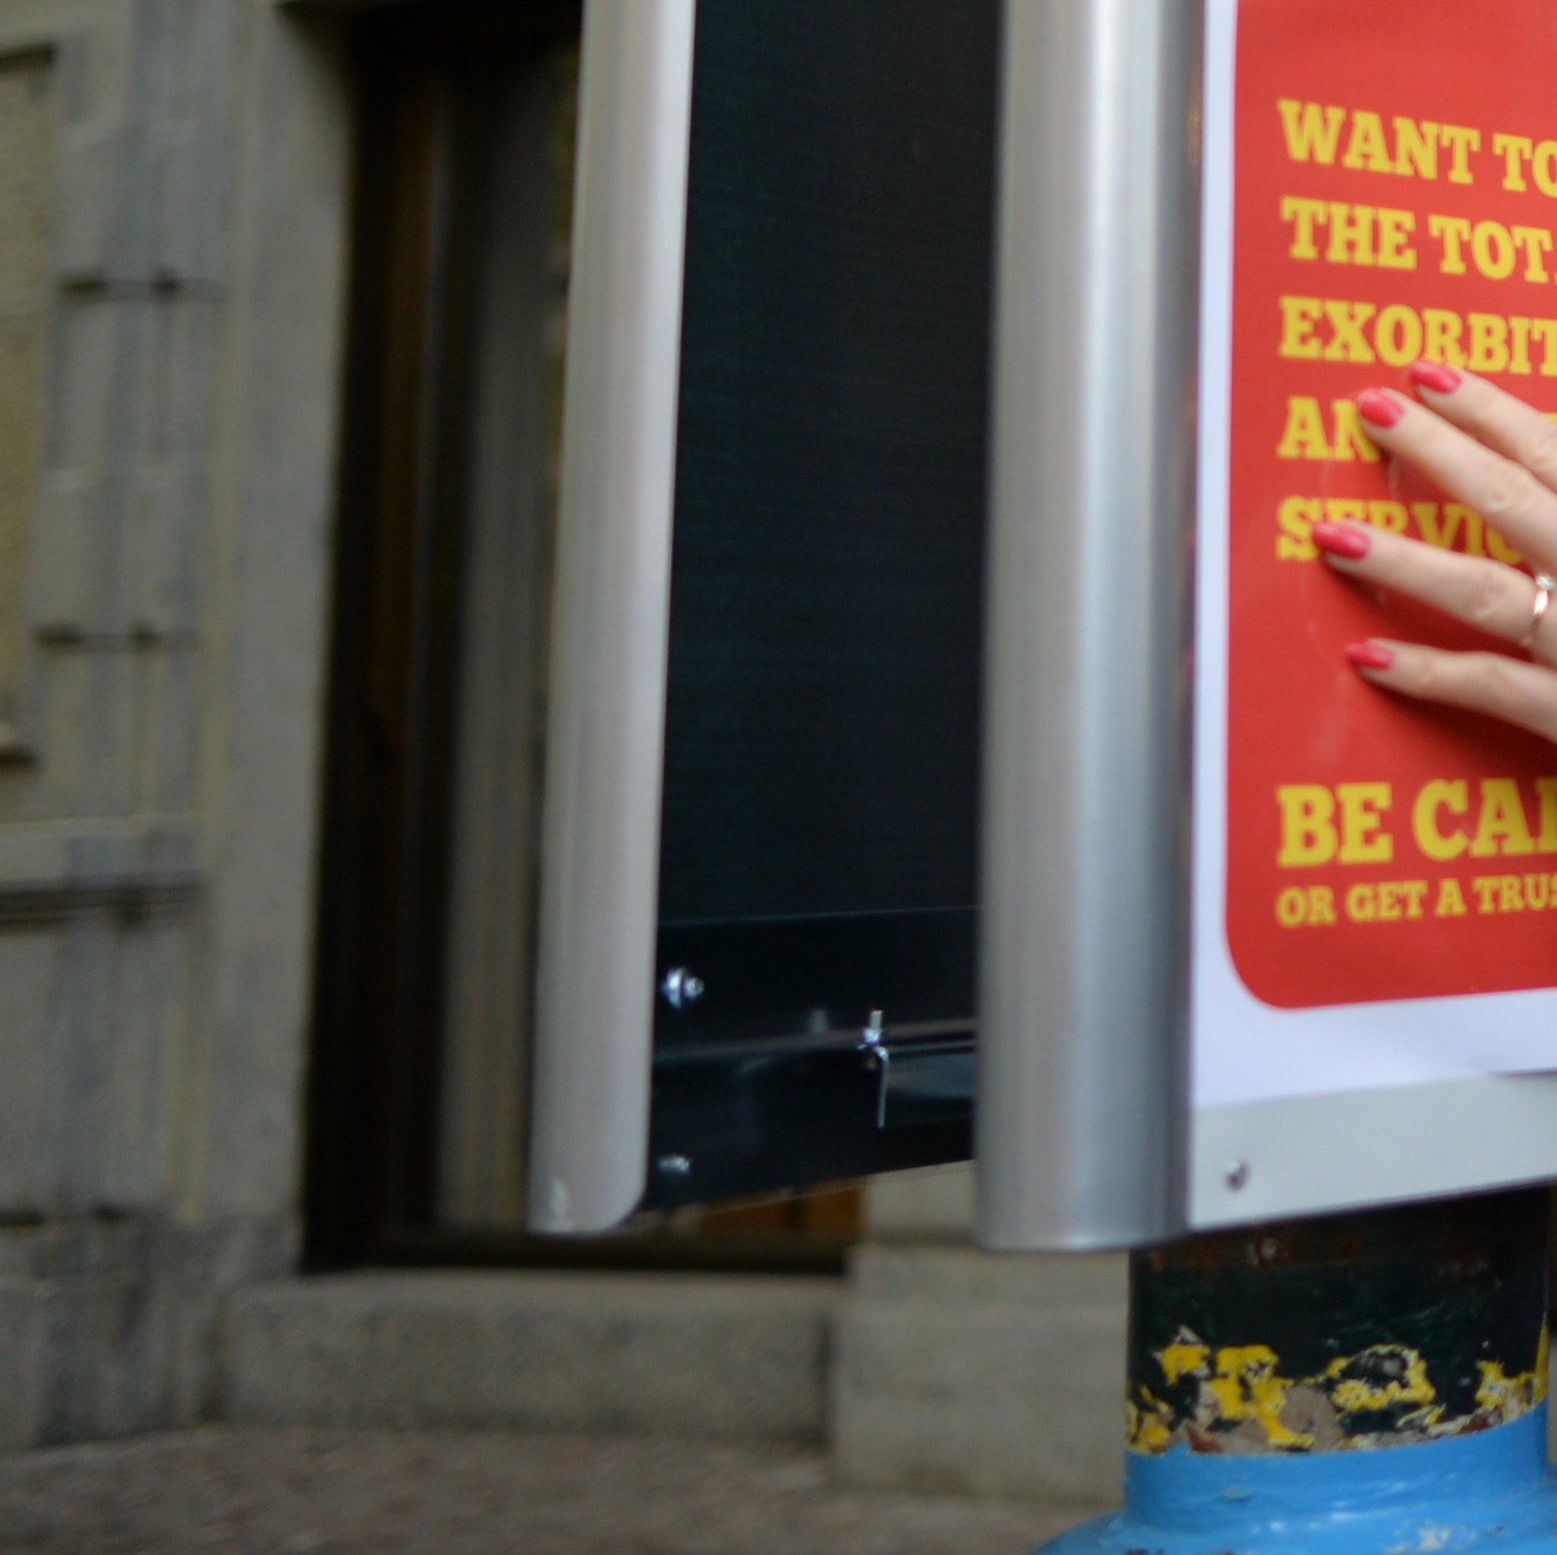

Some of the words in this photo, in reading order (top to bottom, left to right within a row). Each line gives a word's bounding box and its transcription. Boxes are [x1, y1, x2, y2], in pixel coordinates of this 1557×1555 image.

[1276, 99, 1480, 184] WANT
[1281, 197, 1417, 270] THE
[1277, 782, 1393, 867] BE
[1276, 885, 1336, 927] OR
[1346, 880, 1427, 923] GET
[1436, 877, 1467, 916] A
